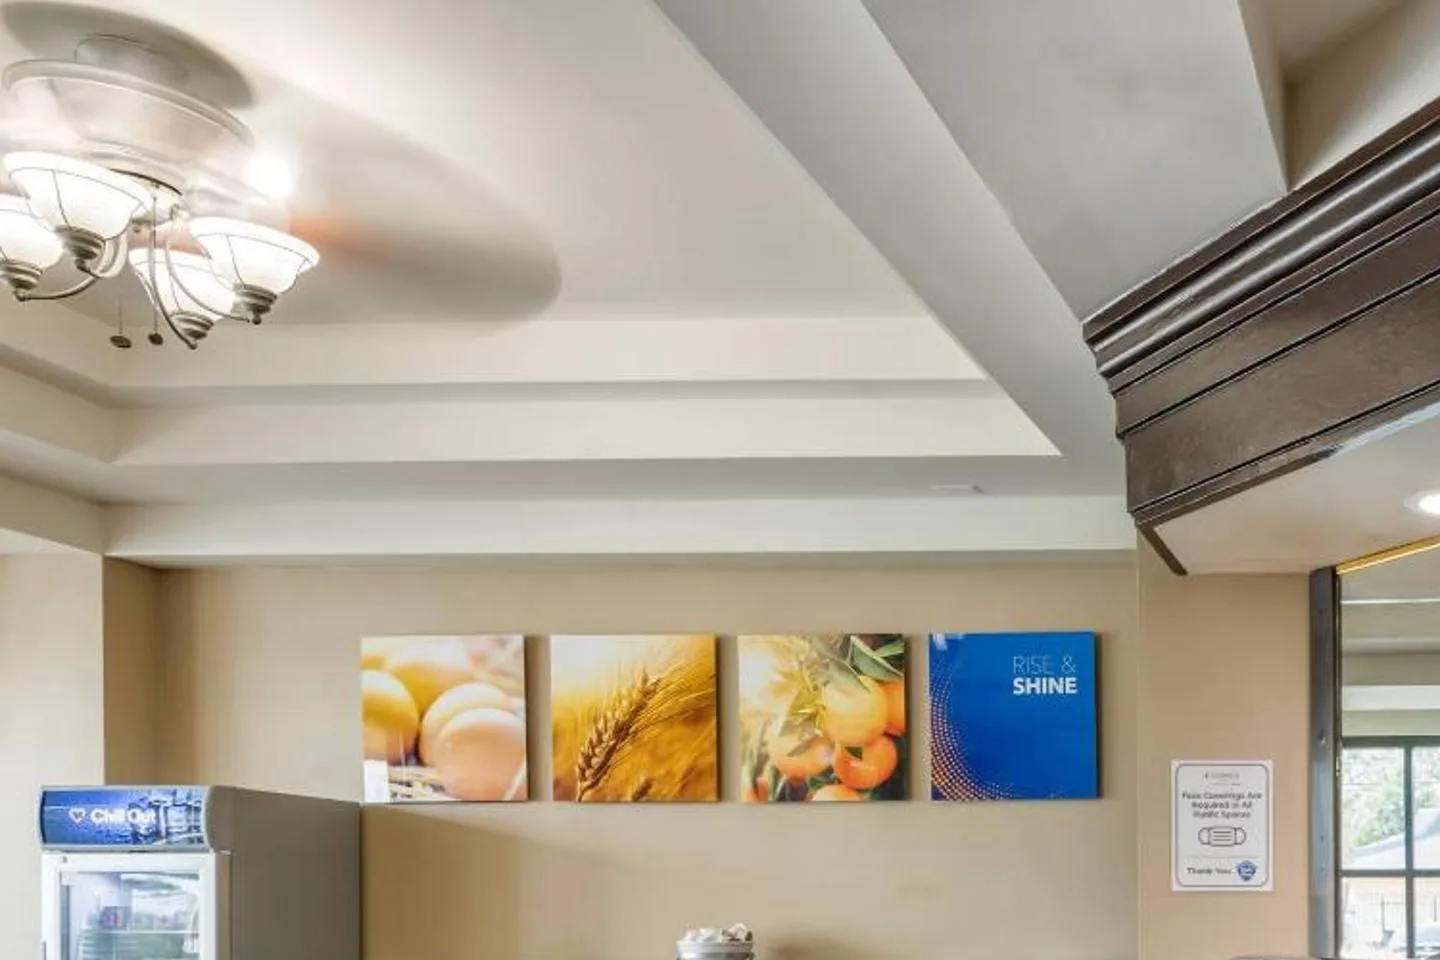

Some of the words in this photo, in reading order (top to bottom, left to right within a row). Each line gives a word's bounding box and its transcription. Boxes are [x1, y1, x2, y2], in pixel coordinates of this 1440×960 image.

[1013, 655, 1054, 675] RISE
[1061, 654, 1077, 675] &
[1012, 677, 1078, 695] SHINE
[1204, 791, 1245, 801] Coverings
[1191, 801, 1230, 810] Required
[91, 807, 125, 825] Chill
[127, 807, 157, 825] Out
[1186, 867, 1213, 875] Thank
